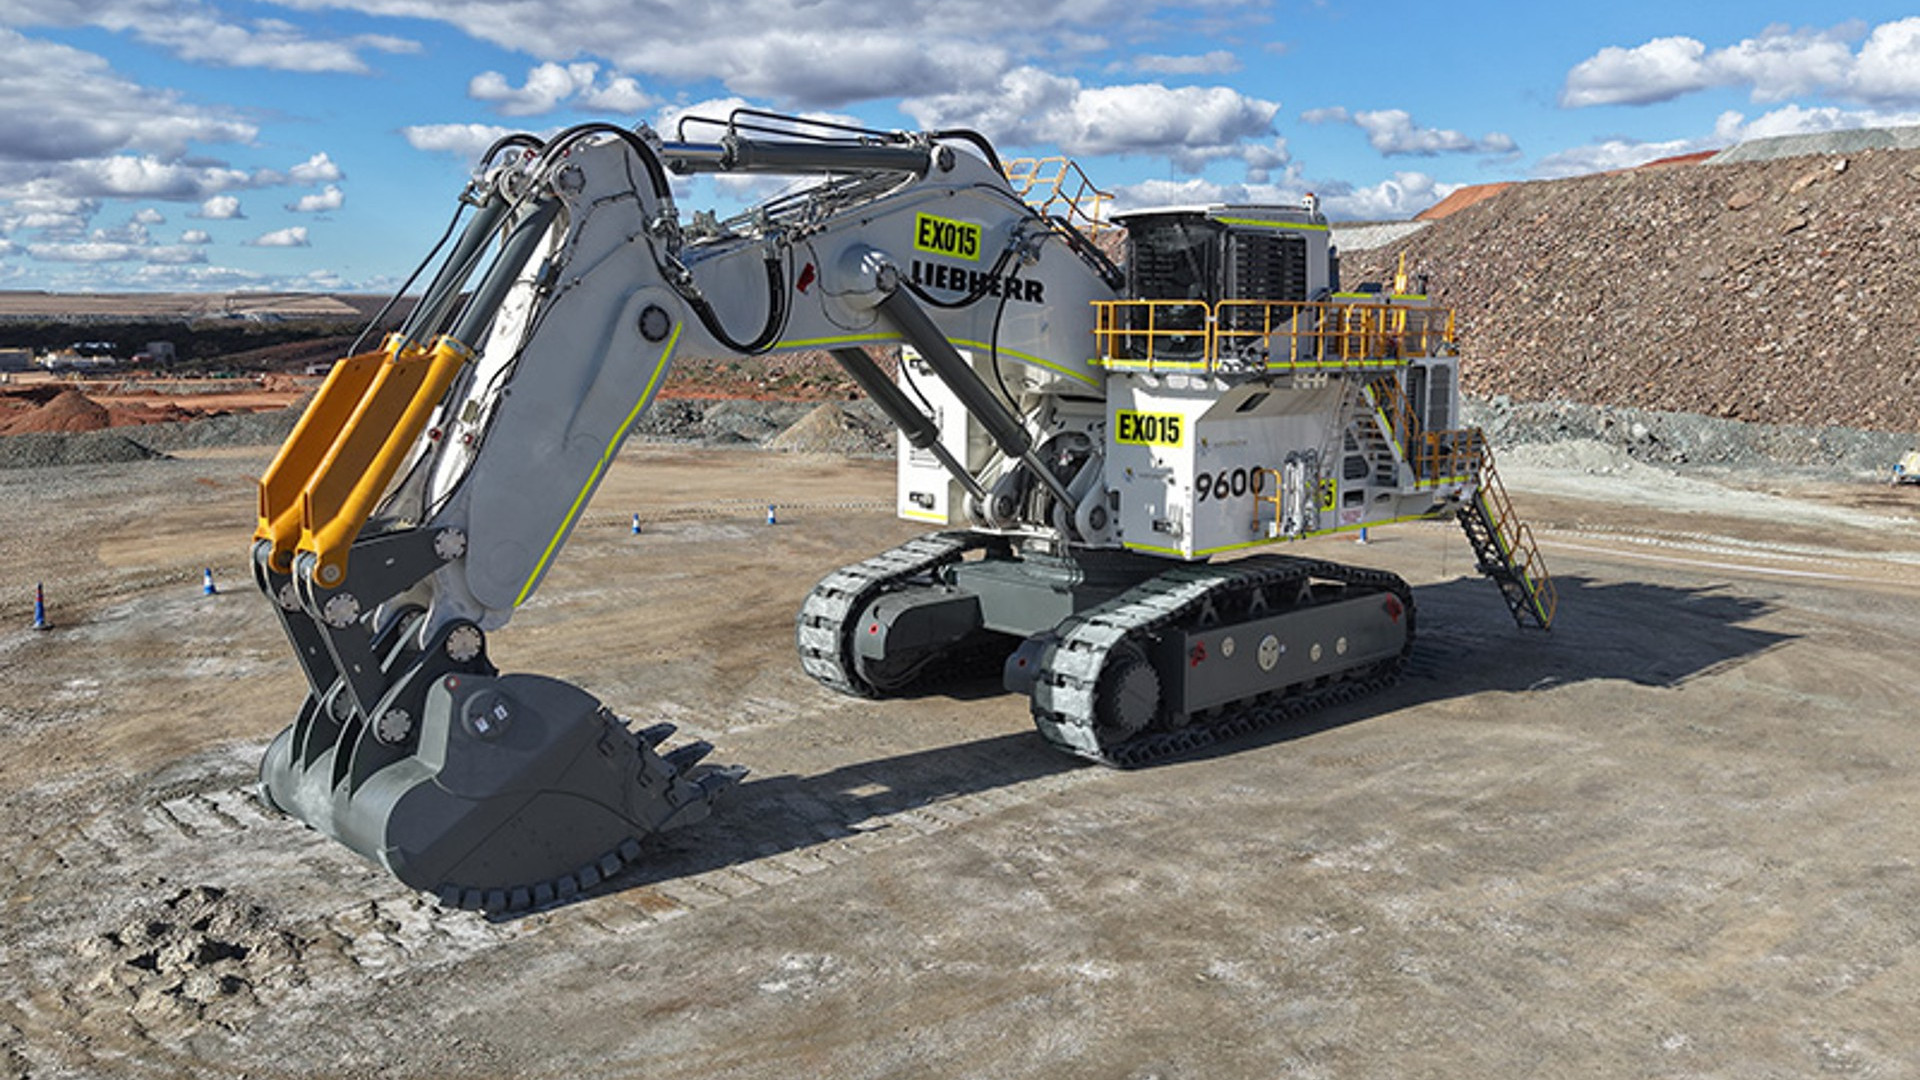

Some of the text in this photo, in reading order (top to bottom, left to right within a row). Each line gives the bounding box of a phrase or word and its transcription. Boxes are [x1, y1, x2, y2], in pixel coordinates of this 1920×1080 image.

[919, 218, 976, 255] EX015
[1119, 414, 1180, 443] EX015
[1196, 466, 1264, 502] 9600
